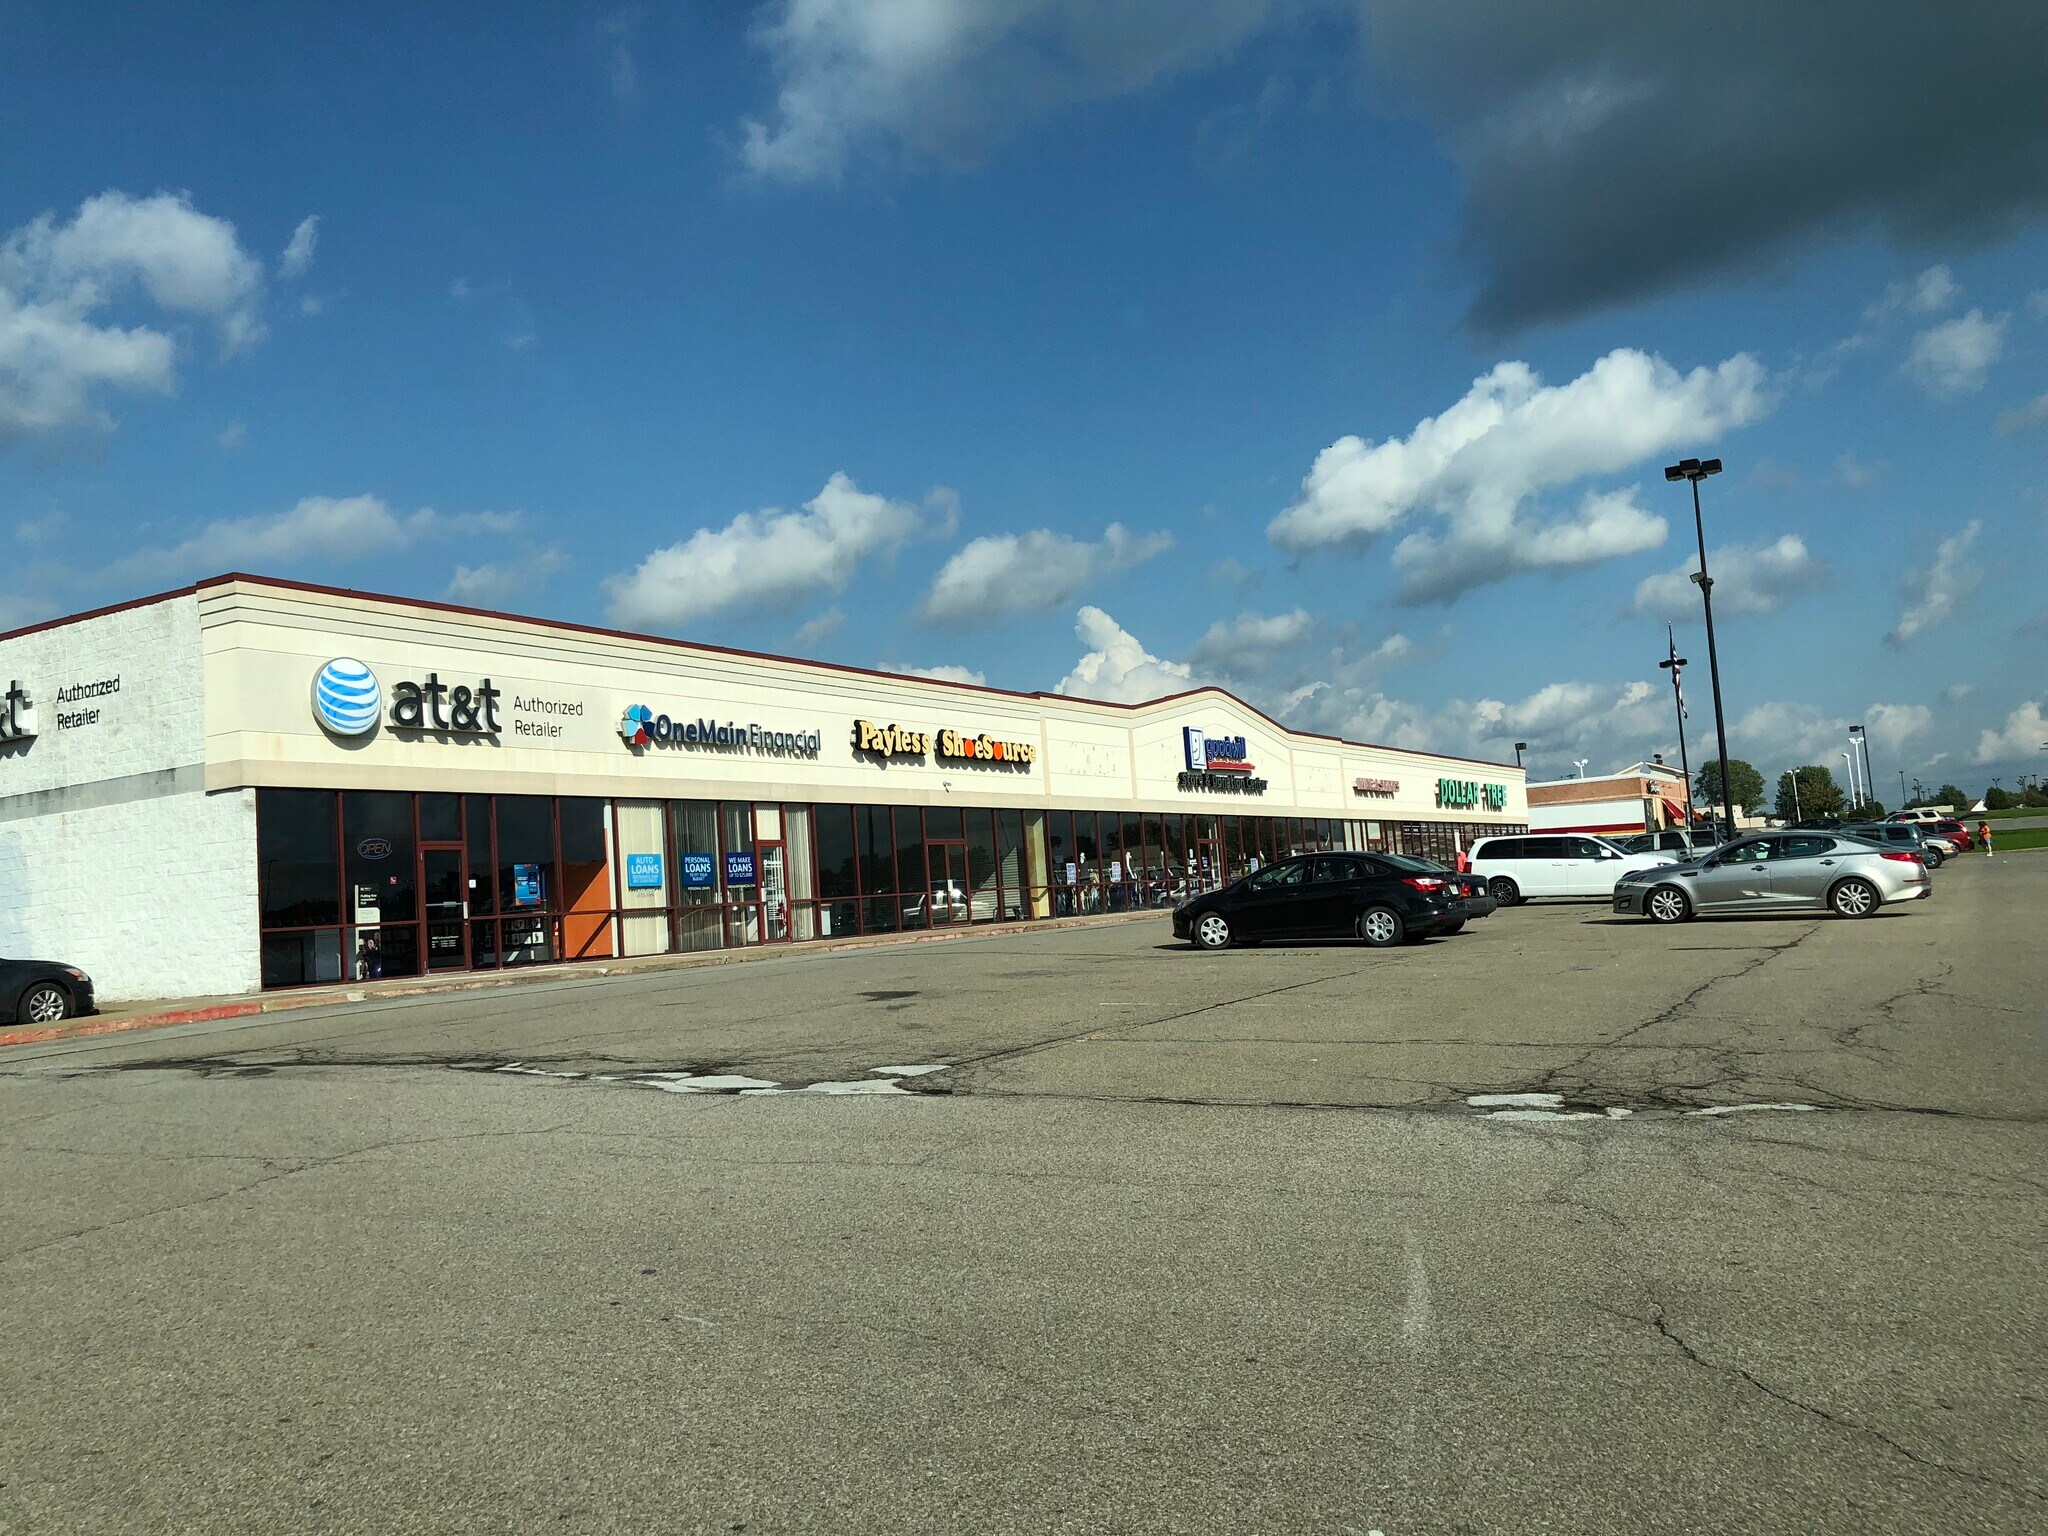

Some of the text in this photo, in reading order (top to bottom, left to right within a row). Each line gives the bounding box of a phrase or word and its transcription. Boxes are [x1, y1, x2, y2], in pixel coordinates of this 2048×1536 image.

[56, 673, 120, 704] Authorized
[393, 673, 502, 733] at&t
[513, 696, 583, 716] Authorized
[57, 707, 100, 731] Retailer
[515, 719, 563, 738] Retailer
[859, 720, 1037, 763] Payless ShoeSource
[1205, 736, 1246, 763] goodwill
[1181, 773, 1204, 785] Store
[1212, 775, 1245, 789] Donation
[1246, 777, 1268, 791] Center
[1439, 778, 1508, 807] DOLLAR TREE
[360, 842, 392, 854] OPEN
[631, 864, 660, 874] LOANS
[635, 856, 654, 864] AUTO
[684, 856, 711, 864] PERSONAL
[685, 863, 712, 873] LOANS
[728, 863, 752, 873] LOANS
